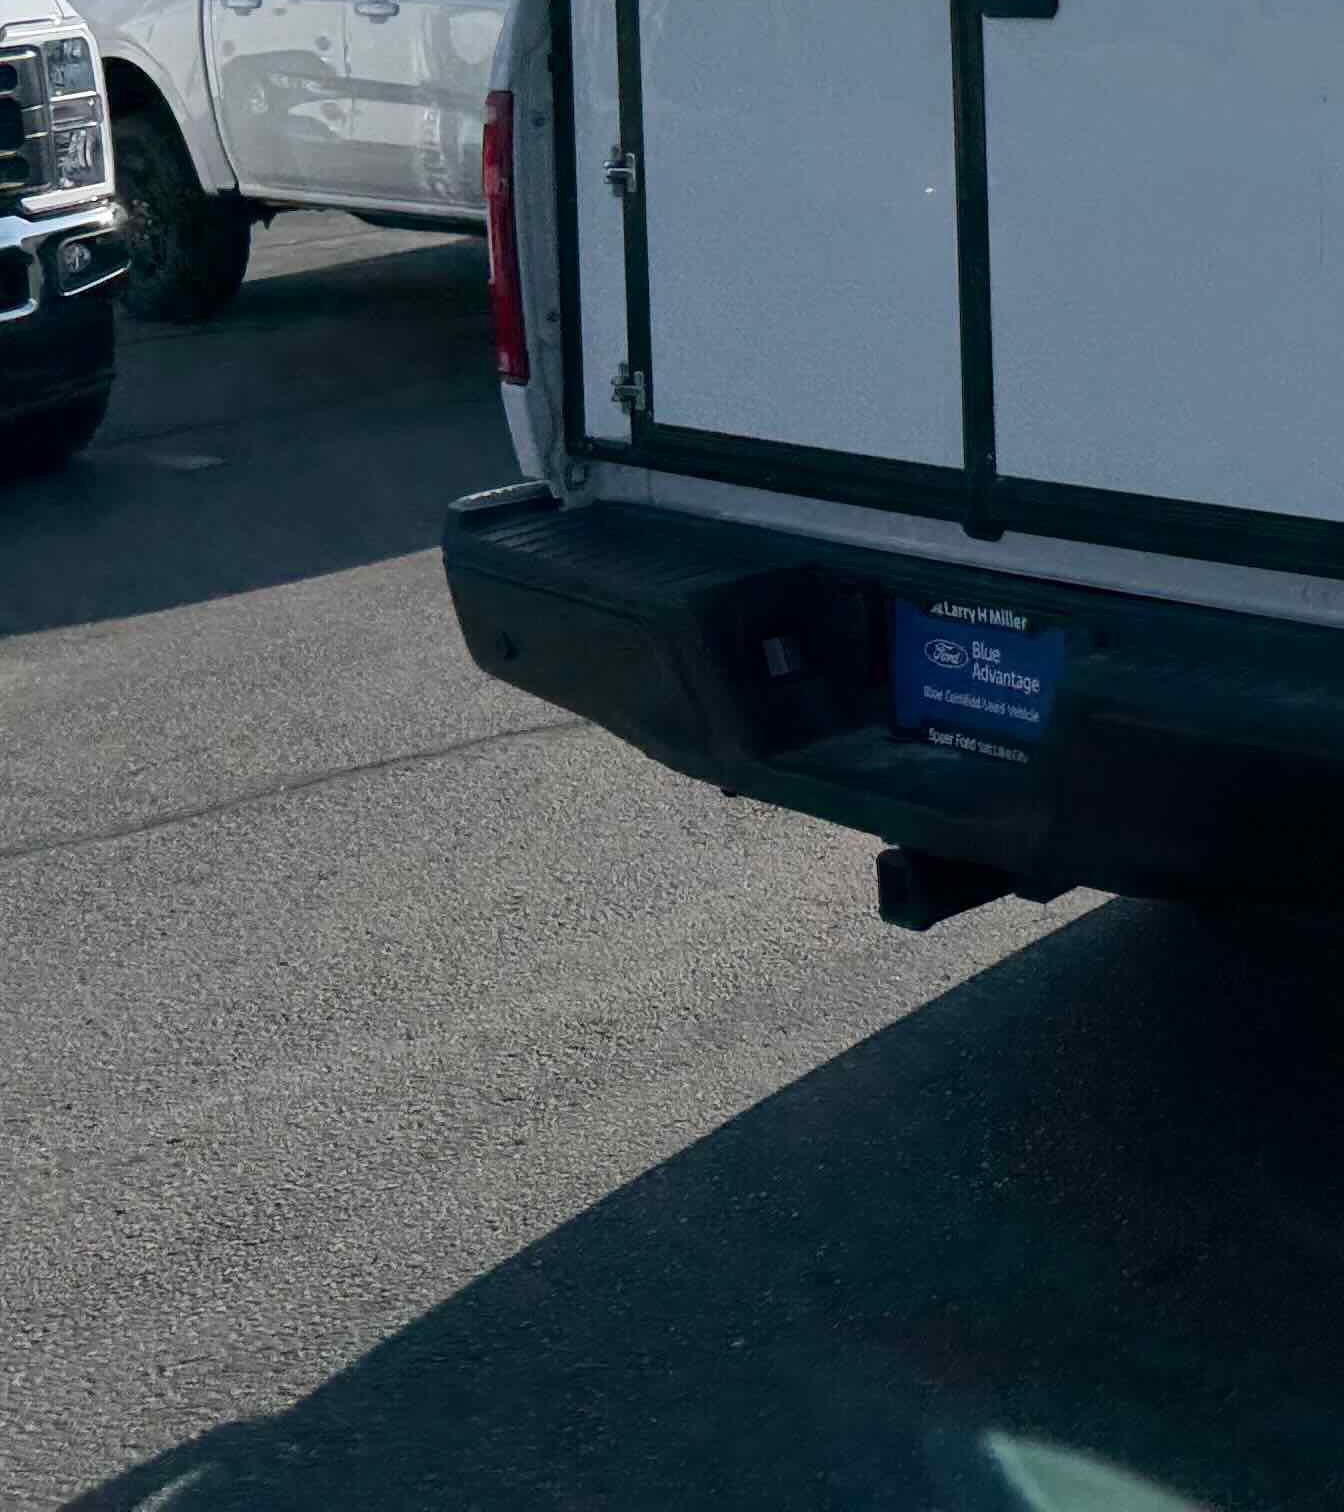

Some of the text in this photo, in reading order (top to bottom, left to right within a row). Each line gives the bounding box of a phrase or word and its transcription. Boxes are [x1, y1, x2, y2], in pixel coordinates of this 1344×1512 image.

[944, 601, 1027, 631] Larry H Miller
[933, 642, 962, 665] Ford
[971, 640, 1000, 663] Blue
[971, 662, 1041, 694] Advantage
